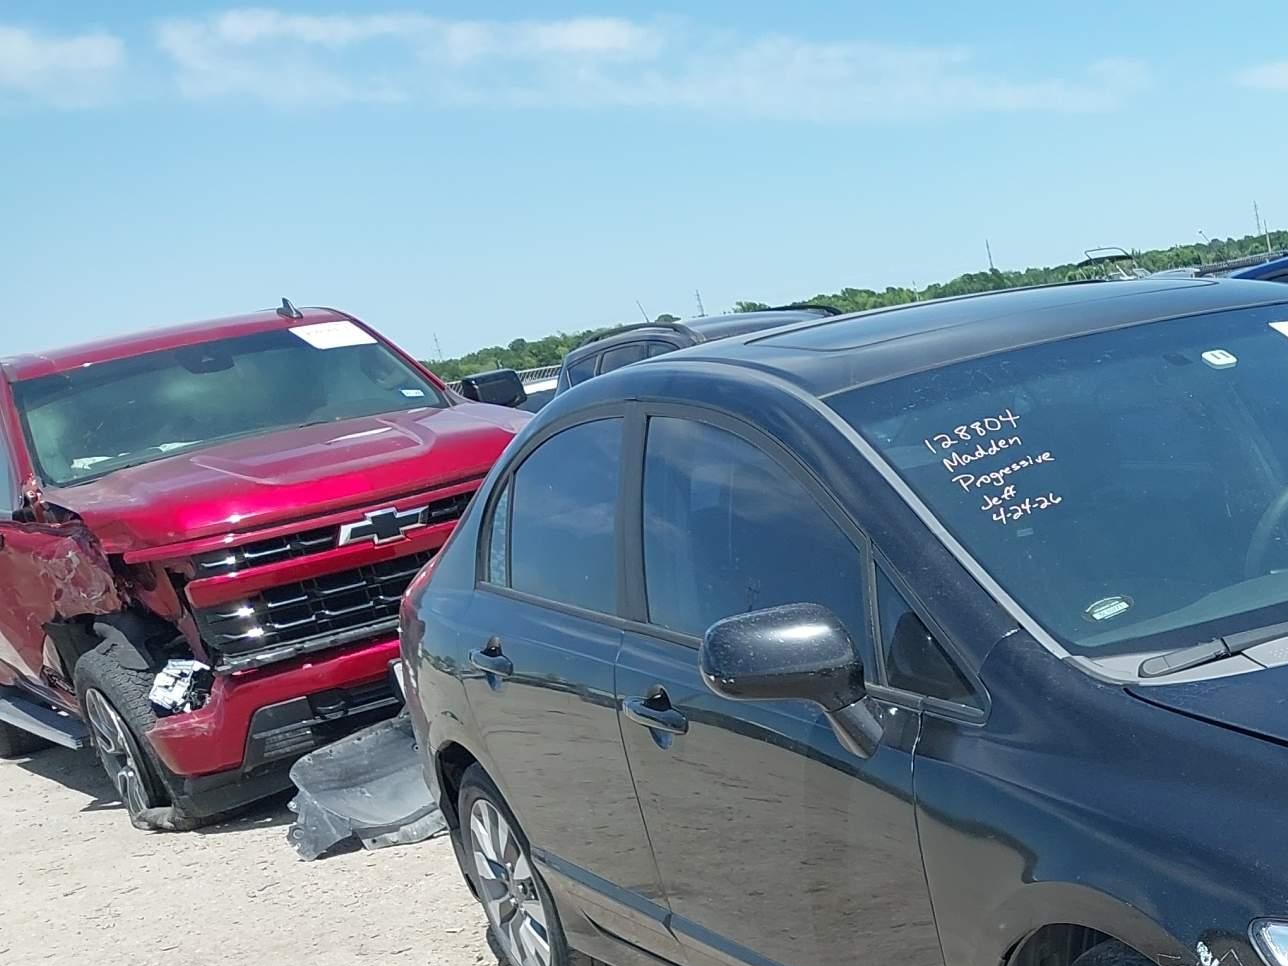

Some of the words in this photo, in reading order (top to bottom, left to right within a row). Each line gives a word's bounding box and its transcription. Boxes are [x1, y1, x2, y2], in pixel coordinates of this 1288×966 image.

[924, 408, 1021, 454] 128804
[942, 435, 1022, 473] Madden
[951, 451, 1056, 493] Progressive
[981, 484, 1017, 511] Jeff
[992, 492, 1063, 525] 4-24-26
